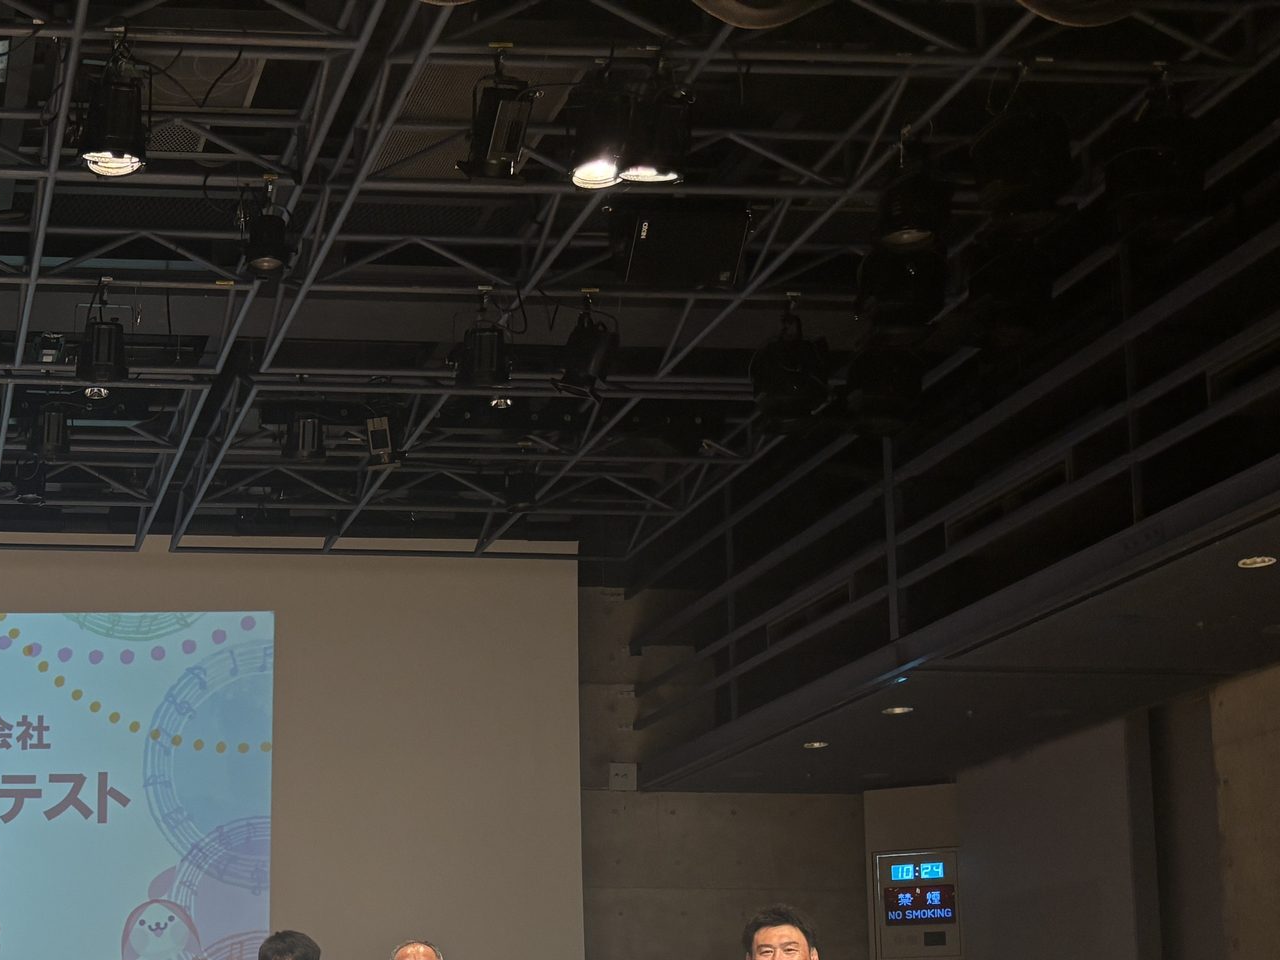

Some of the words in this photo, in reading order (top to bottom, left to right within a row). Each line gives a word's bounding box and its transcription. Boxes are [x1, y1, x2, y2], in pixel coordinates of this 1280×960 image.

[897, 864, 943, 879] 10:24
[897, 891, 941, 906] 禁煙
[888, 910, 903, 920] NO
[905, 908, 952, 919] SMOKING
